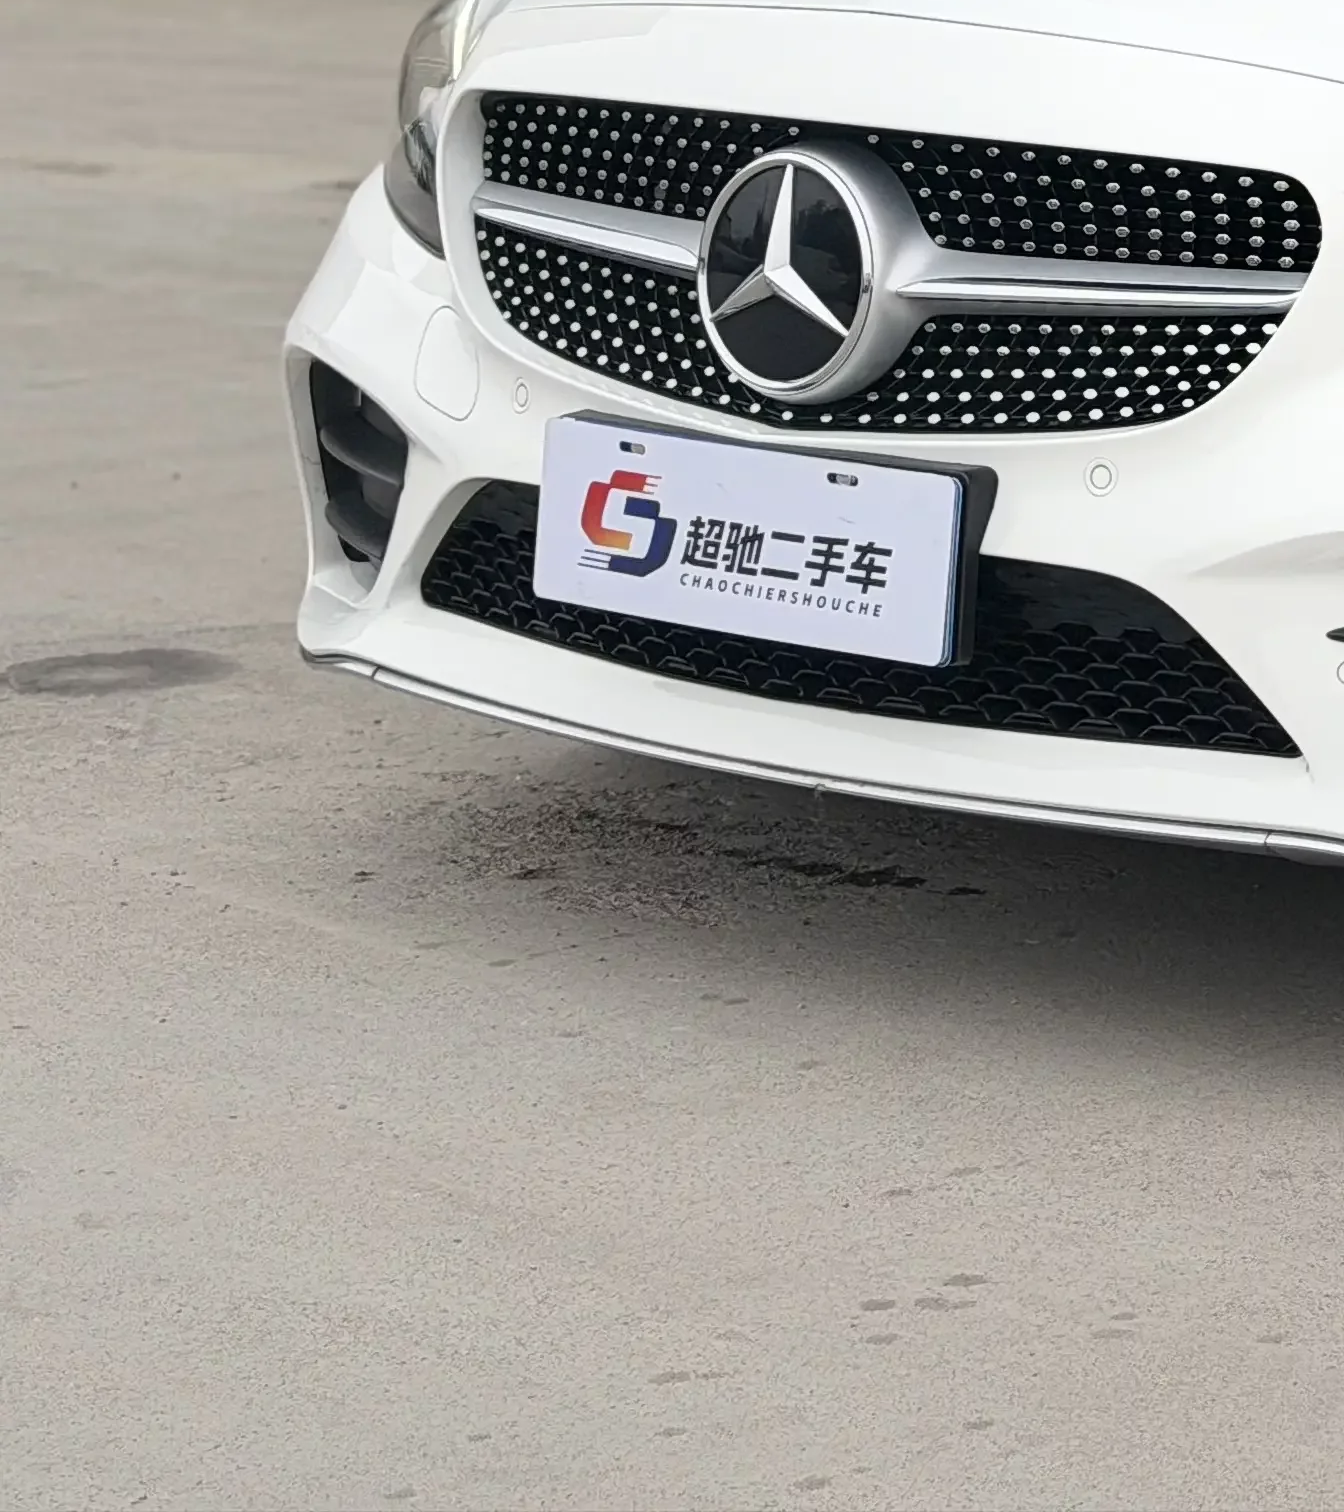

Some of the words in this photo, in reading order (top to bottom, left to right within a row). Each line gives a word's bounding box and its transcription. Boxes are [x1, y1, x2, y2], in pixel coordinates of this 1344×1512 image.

[680, 516, 893, 594] 超驰二手车
[680, 573, 883, 617] CHAOCHIERSHOUCHE
